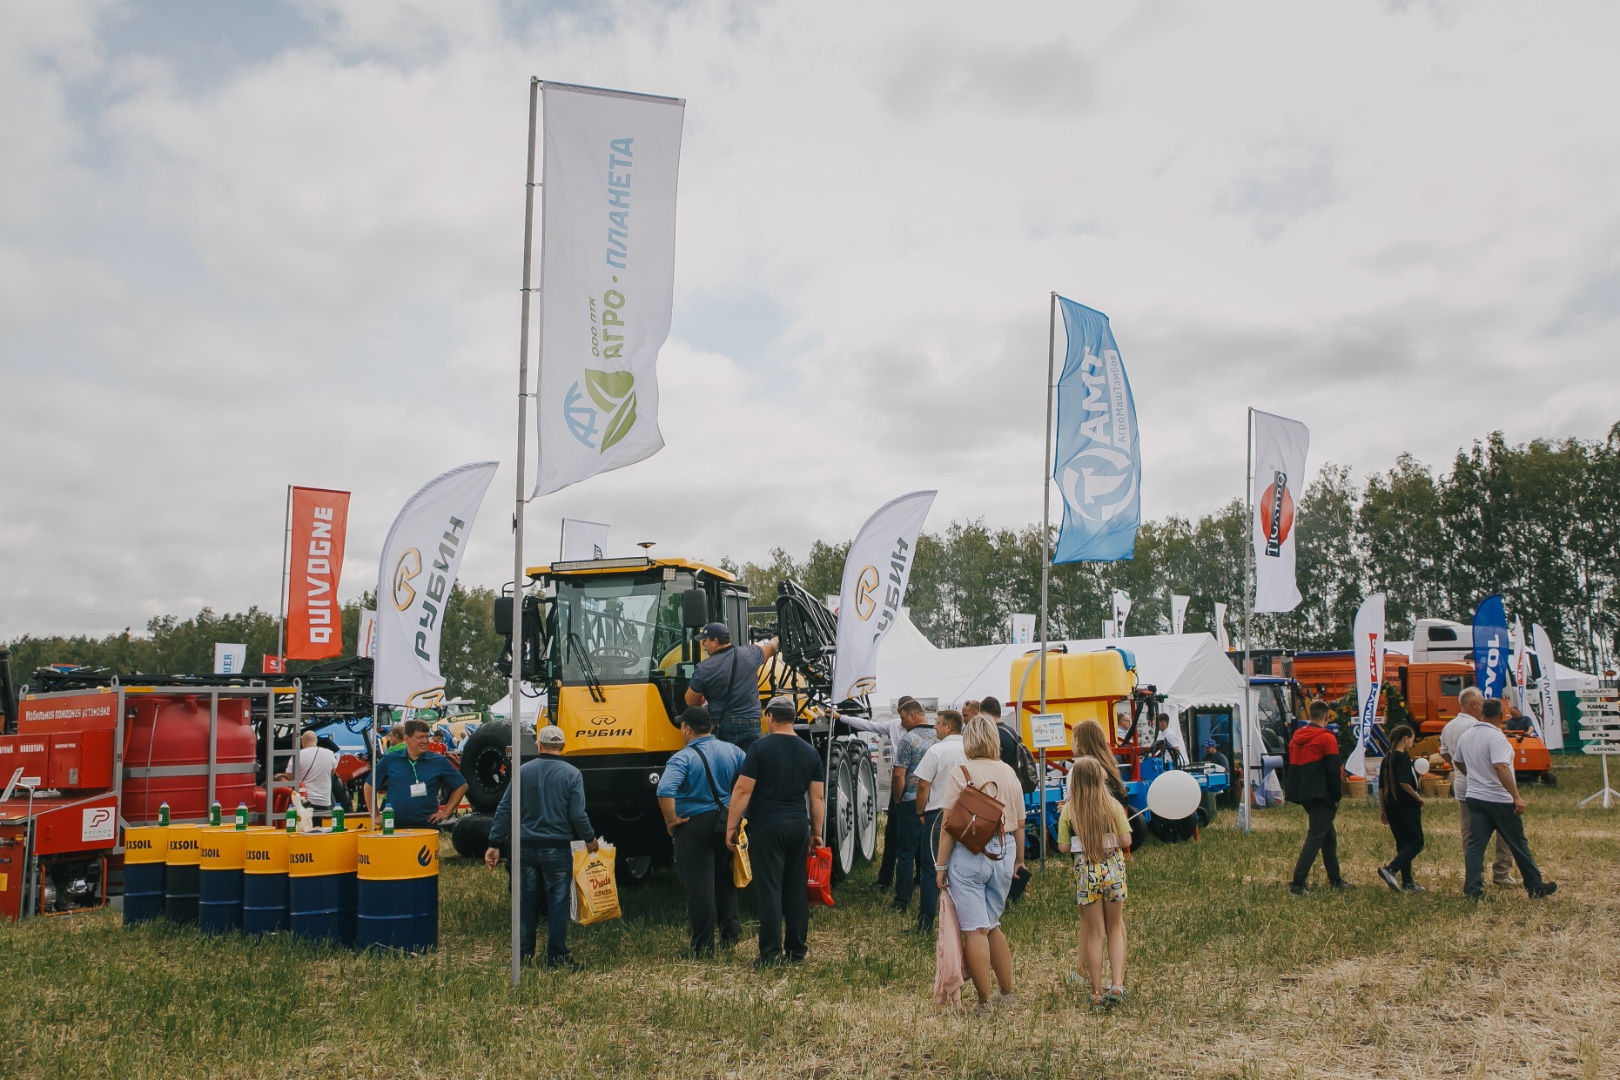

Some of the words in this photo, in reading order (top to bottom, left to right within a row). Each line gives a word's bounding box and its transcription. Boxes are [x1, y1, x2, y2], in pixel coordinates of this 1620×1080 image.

[606, 137, 635, 270] ПЛАНЕТА
[589, 296, 598, 323] ПТК
[603, 289, 626, 359] АГРО
[591, 328, 600, 357] ООО
[1081, 346, 1111, 446] АМТ
[1109, 355, 1127, 443] АгроМашТамбов
[306, 506, 334, 643] QUIVOGNE
[414, 515, 466, 662] РУБИН
[223, 654, 233, 673] UER
[1485, 634, 1500, 700] OVOL
[26, 710, 55, 721] Мобильная
[82, 706, 111, 718] установка
[575, 728, 634, 738] РУБИН
[126, 840, 153, 850] EXSOIL
[170, 840, 199, 850] EXSOIL
[246, 851, 271, 861] EXSOIL
[358, 855, 371, 865] OIL
